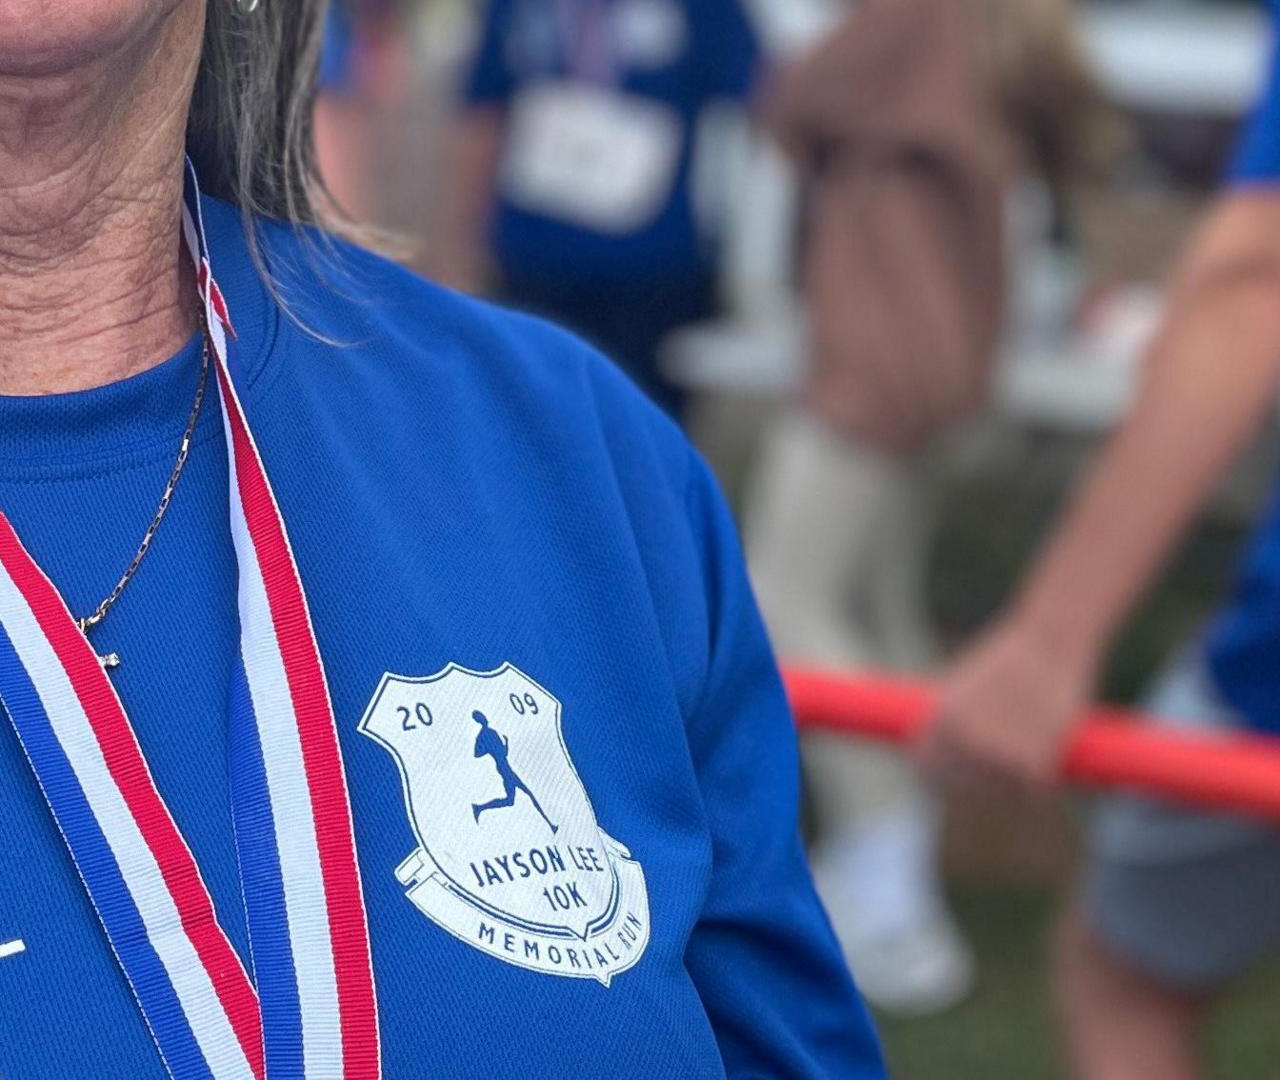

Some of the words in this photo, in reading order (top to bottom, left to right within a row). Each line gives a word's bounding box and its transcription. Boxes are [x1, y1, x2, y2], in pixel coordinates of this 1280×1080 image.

[397, 703, 433, 731] 20
[509, 693, 539, 715] 09
[470, 845, 566, 888] JAYSON
[567, 845, 604, 872] LEE
[543, 881, 588, 912] 10K
[478, 922, 620, 970] MEMORIAL
[617, 912, 642, 950] RUN
